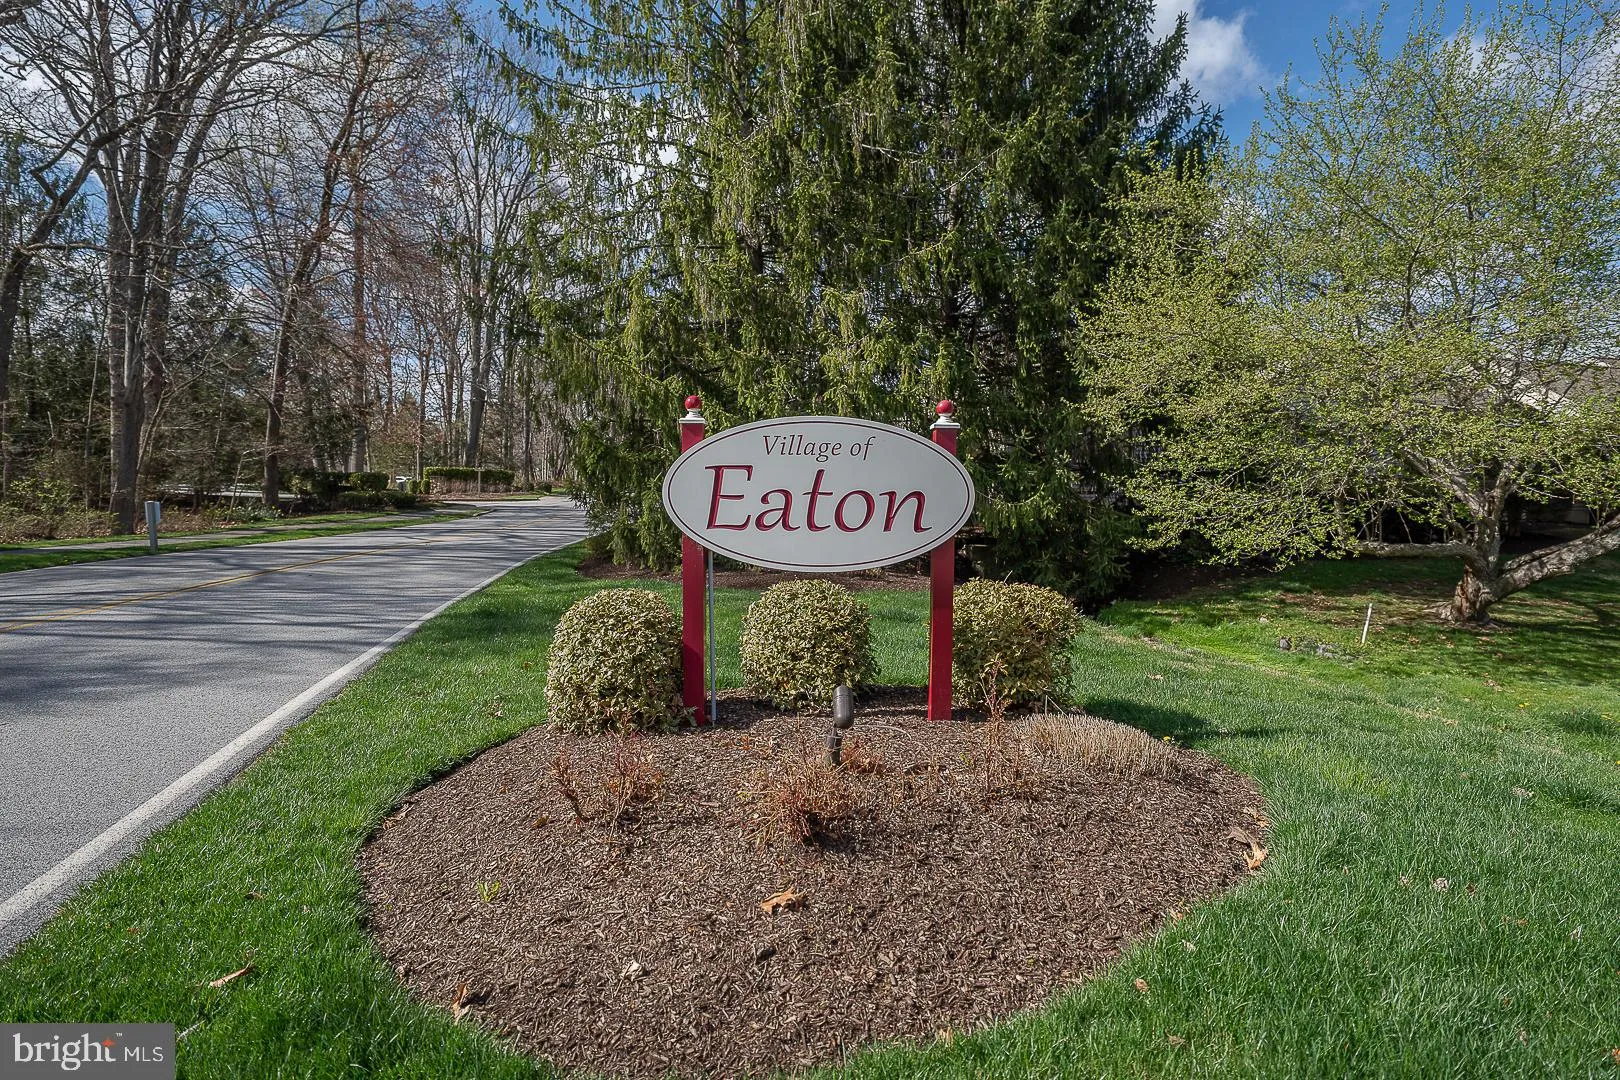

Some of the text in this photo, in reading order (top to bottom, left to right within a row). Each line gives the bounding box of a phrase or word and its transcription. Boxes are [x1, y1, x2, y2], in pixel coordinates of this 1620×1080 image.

[763, 434, 876, 463] Village of
[704, 464, 932, 534] Eaton
